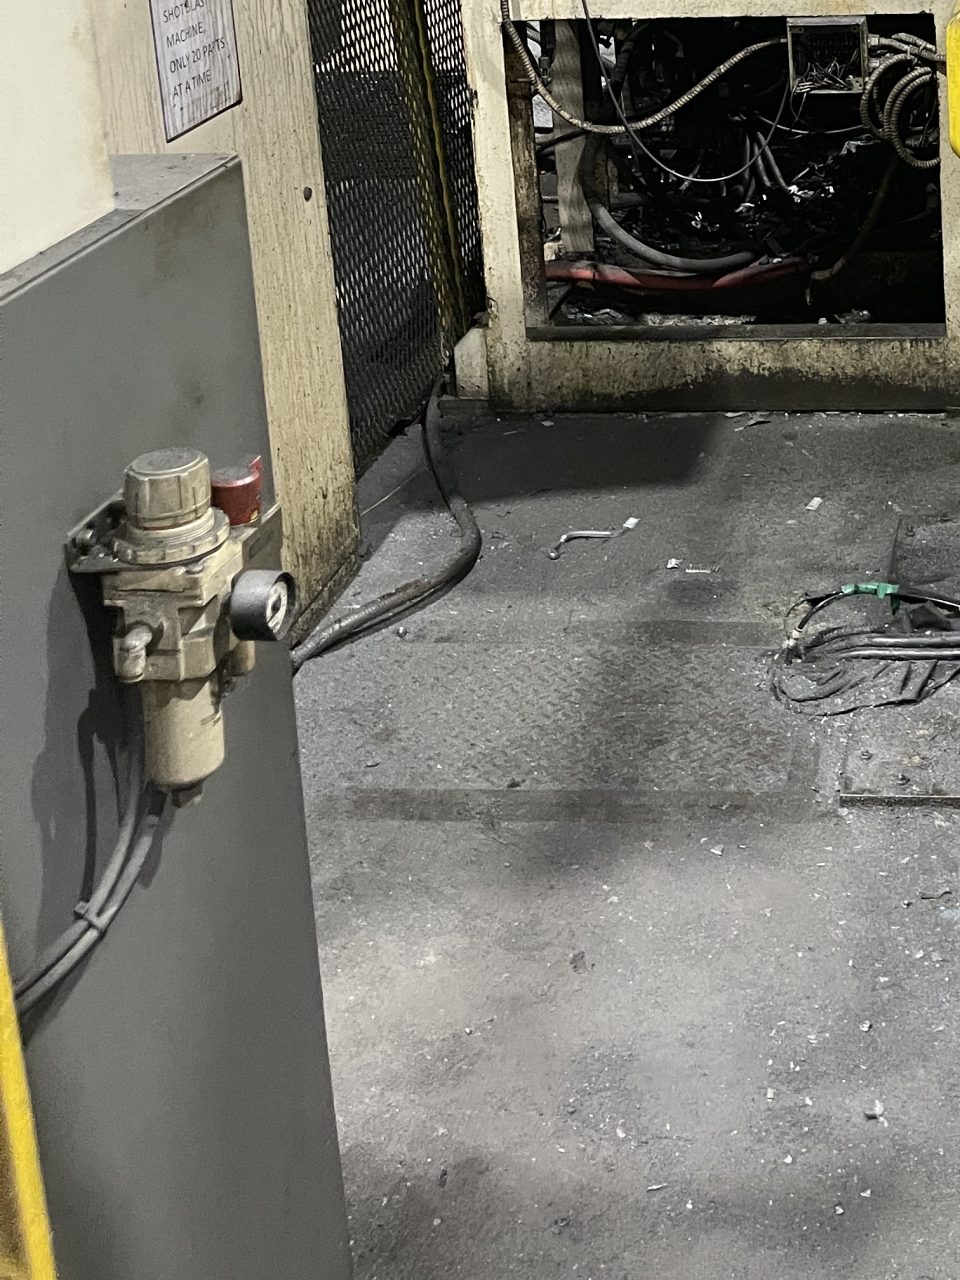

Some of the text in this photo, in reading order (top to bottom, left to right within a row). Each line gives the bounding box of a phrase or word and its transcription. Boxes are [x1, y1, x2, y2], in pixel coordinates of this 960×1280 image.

[169, 52, 190, 73] ONLY
[191, 48, 202, 63] 20
[173, 69, 212, 99] AT A TIME
